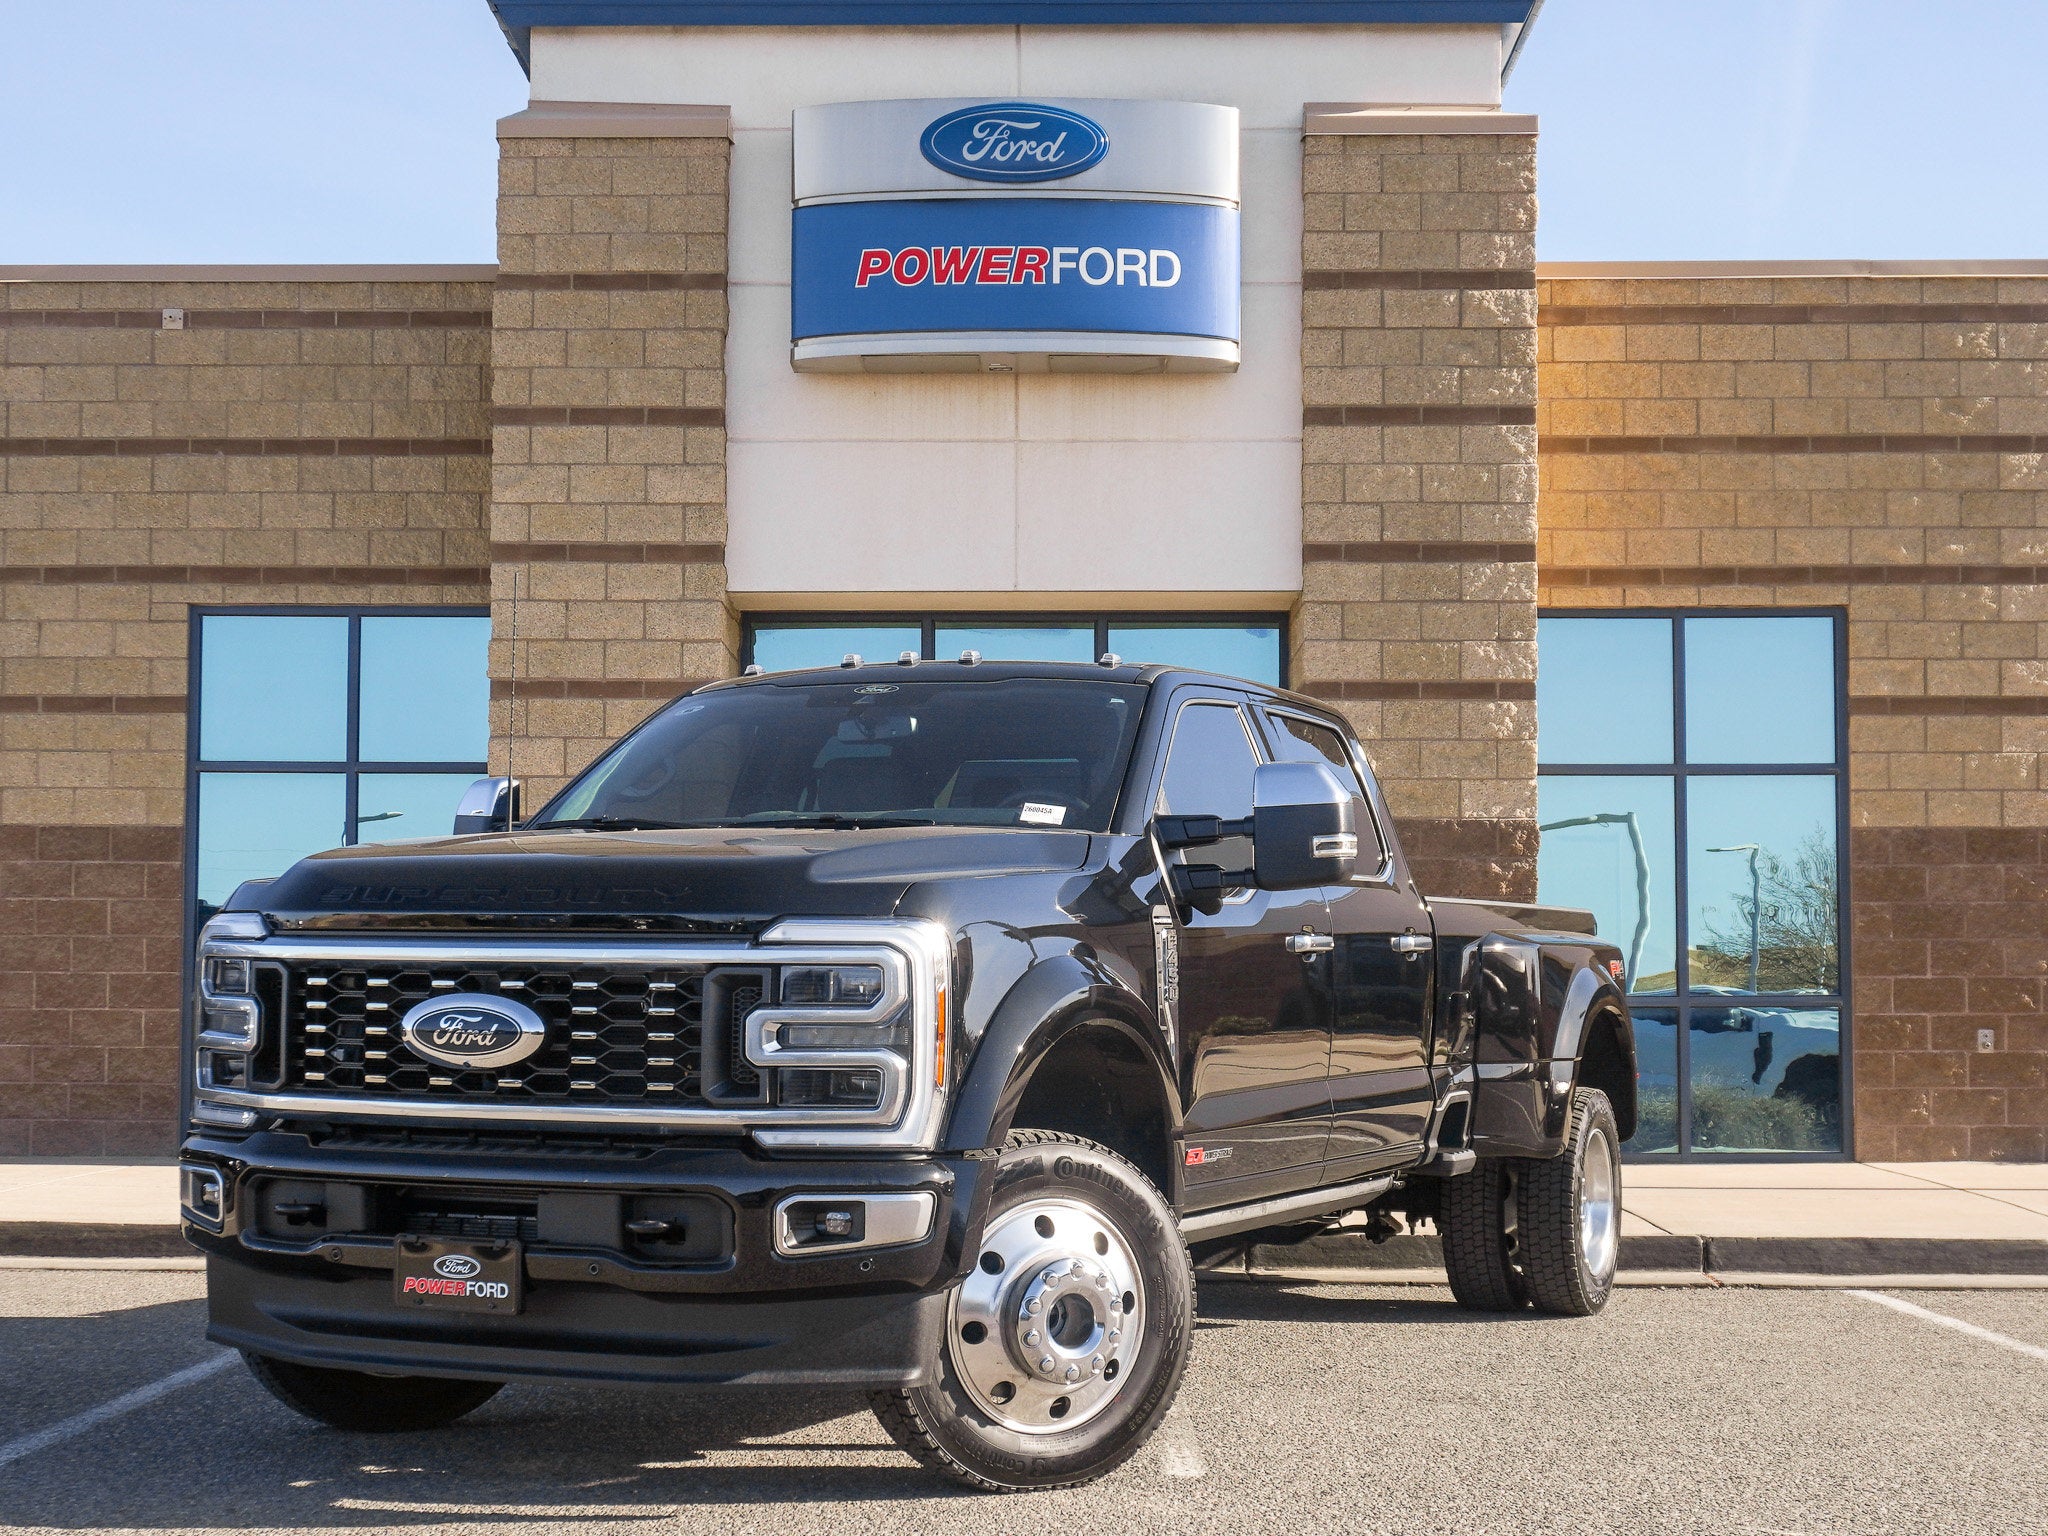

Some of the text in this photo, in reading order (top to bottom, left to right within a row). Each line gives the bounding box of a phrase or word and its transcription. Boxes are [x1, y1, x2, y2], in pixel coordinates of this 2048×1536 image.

[962, 119, 1067, 162] Ford
[855, 246, 1182, 288] POWERFORD
[432, 1014, 499, 1046] Ford
[443, 1259, 472, 1274] Ford
[403, 1277, 509, 1299] POWERFORD
